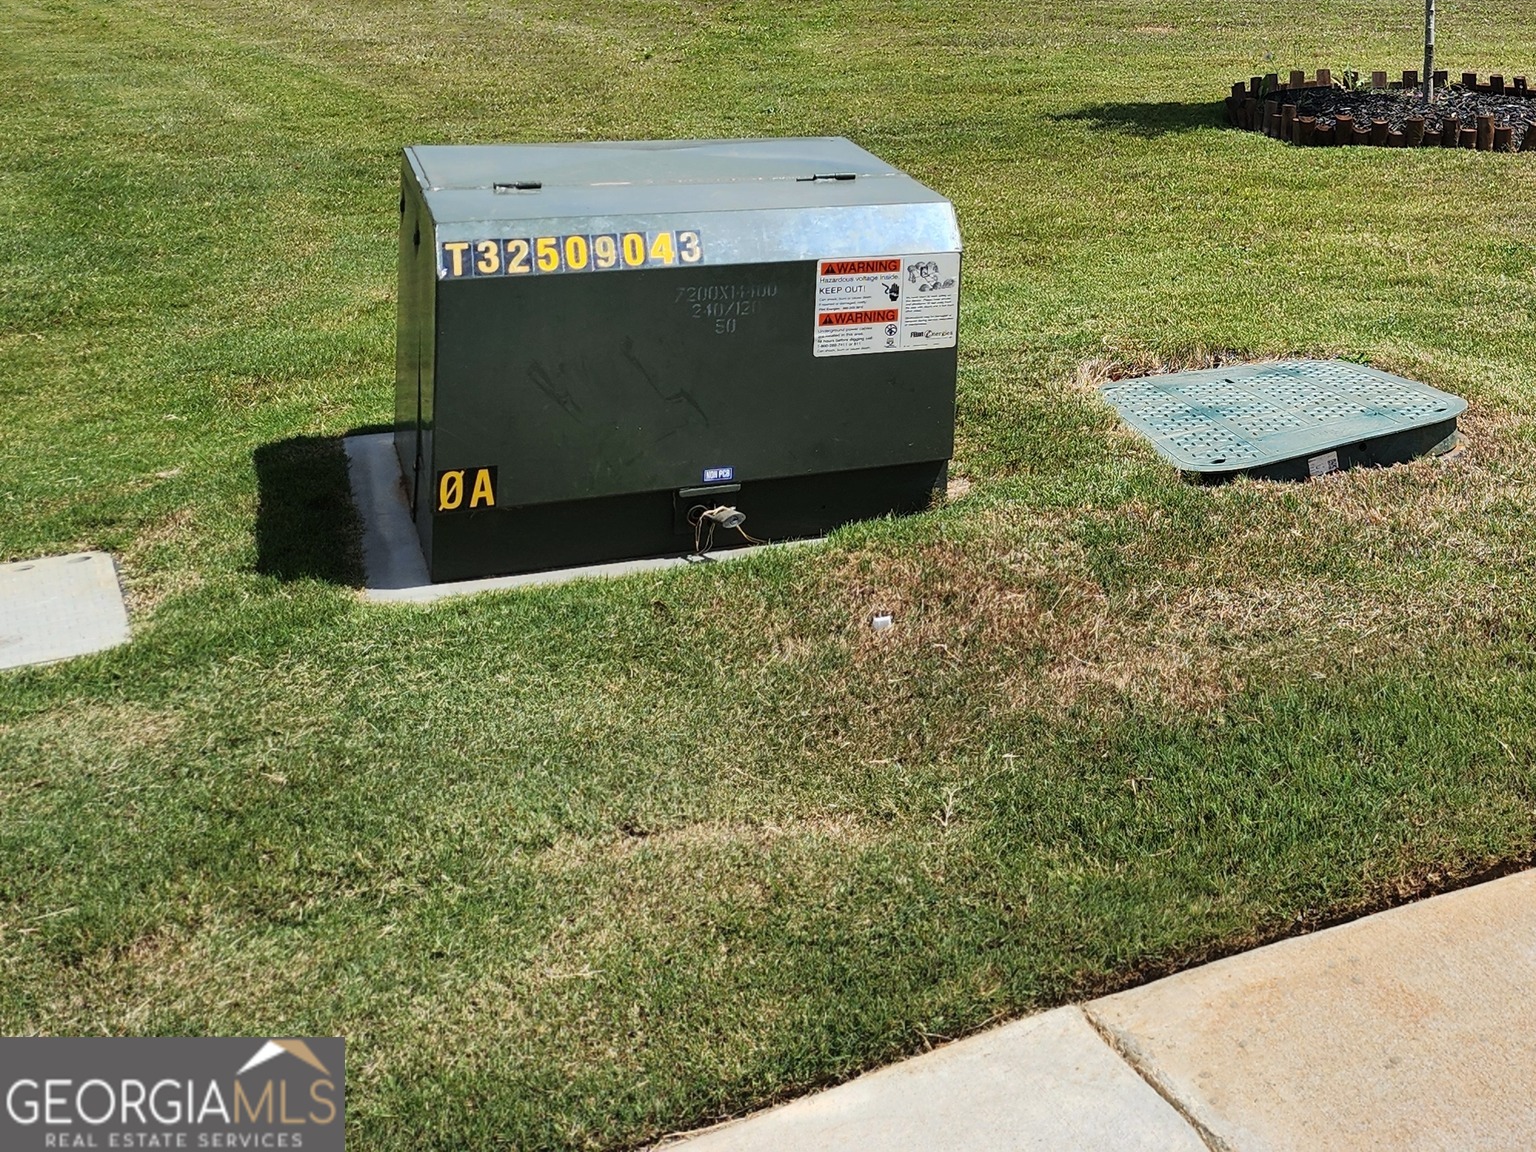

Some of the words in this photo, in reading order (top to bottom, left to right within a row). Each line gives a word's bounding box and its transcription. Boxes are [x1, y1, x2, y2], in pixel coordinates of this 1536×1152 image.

[445, 231, 700, 276] T32509043
[837, 260, 897, 273] WARNING
[819, 275, 853, 283] Hazardous
[819, 286, 843, 295] KEEP
[844, 285, 866, 293] OUT!
[691, 300, 761, 318] 240/120
[834, 310, 895, 324] WARNING
[714, 318, 737, 335] 50
